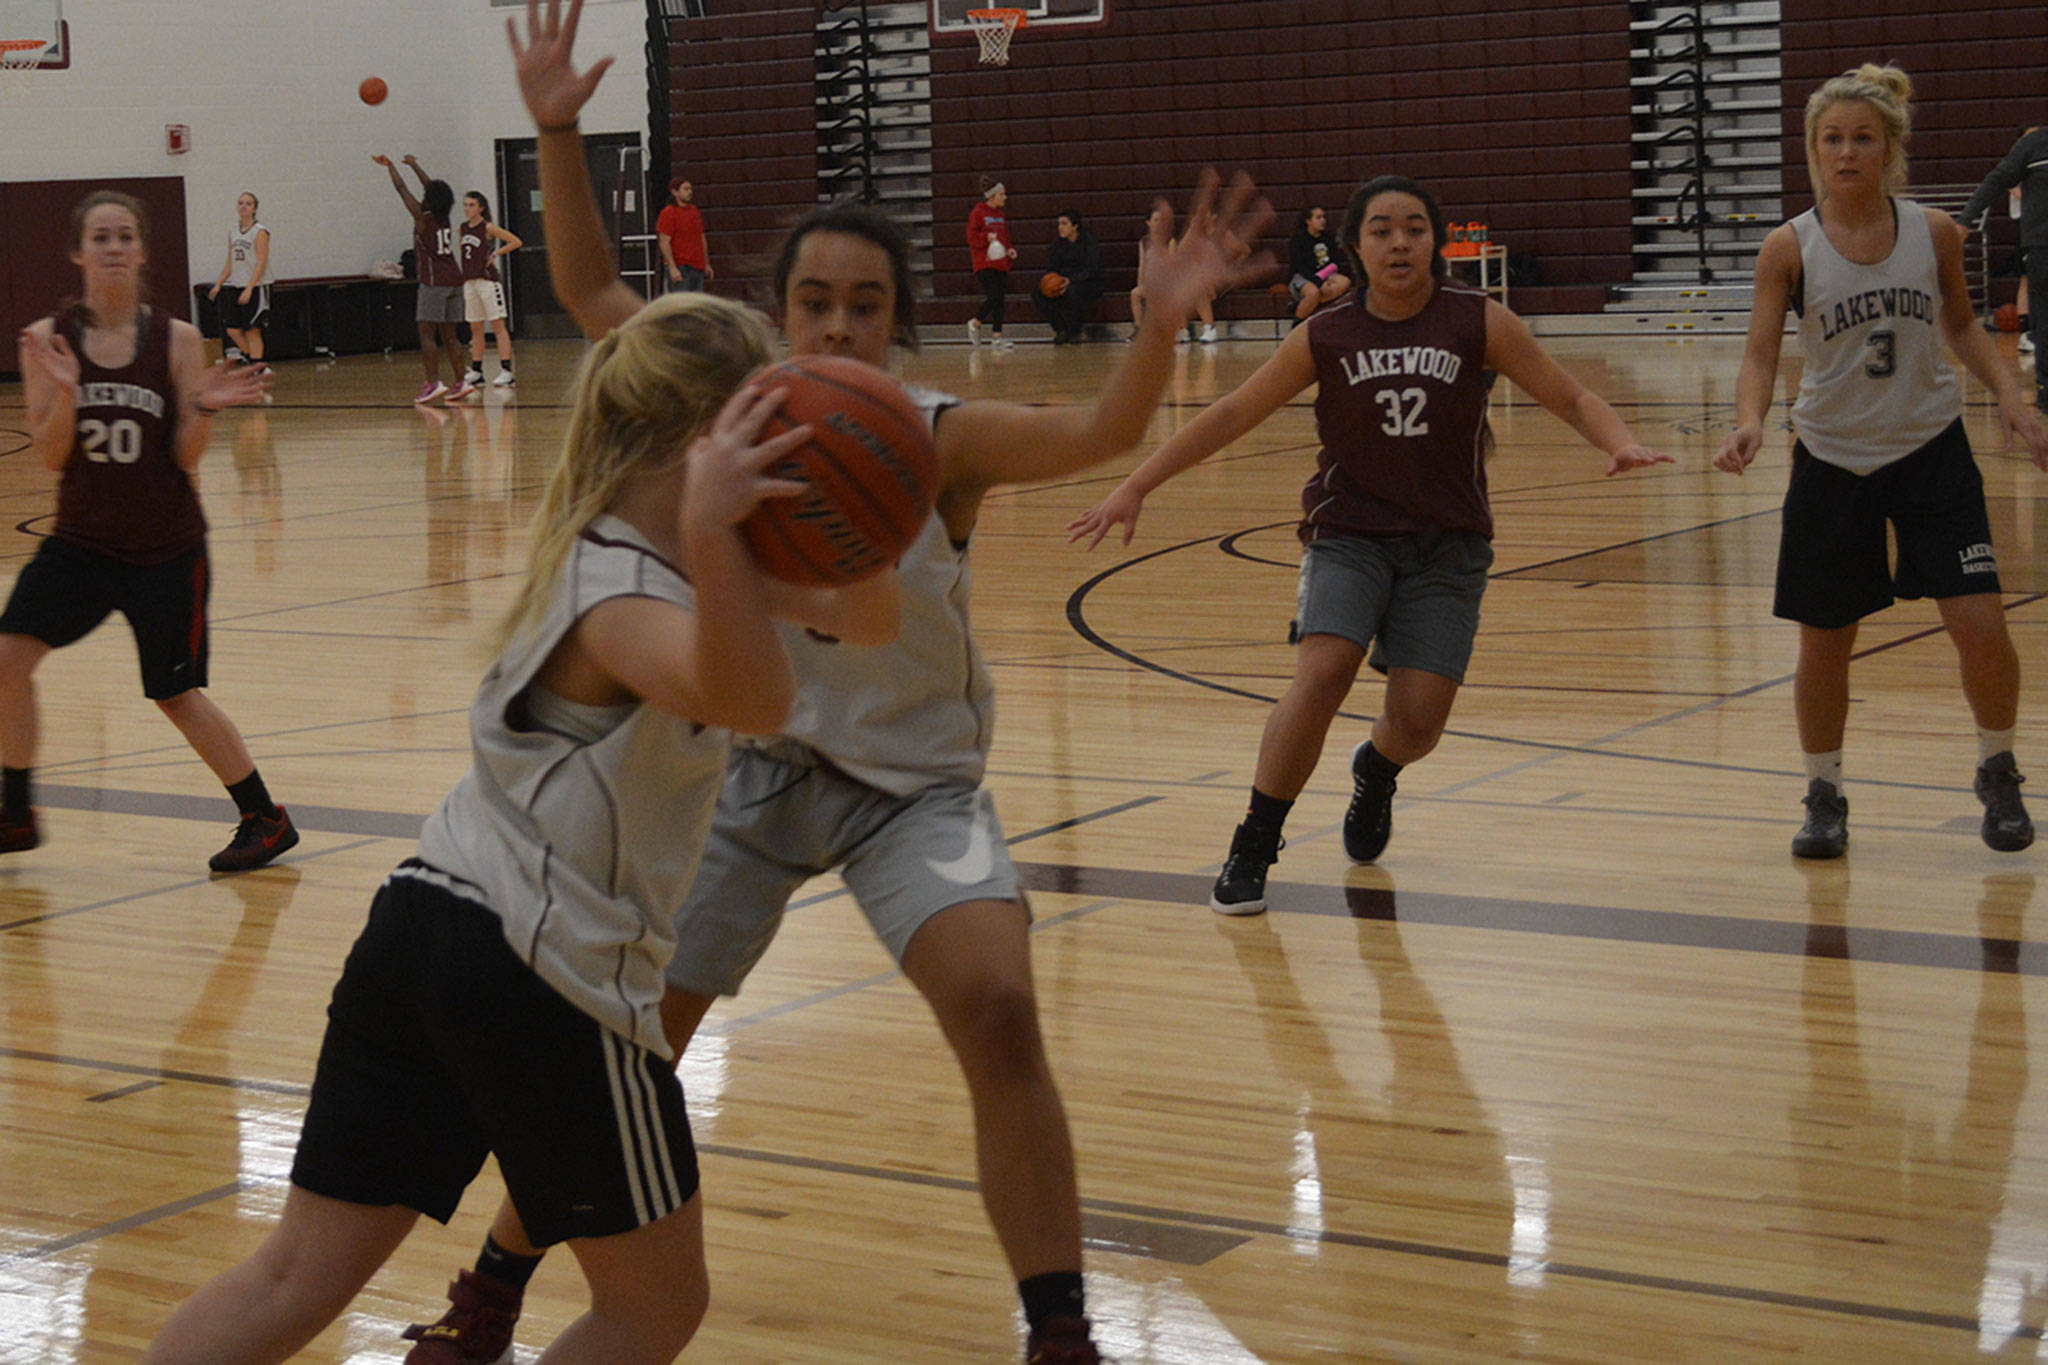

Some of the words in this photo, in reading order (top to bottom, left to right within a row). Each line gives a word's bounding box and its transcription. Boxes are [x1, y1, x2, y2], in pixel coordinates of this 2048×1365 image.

[436, 228, 451, 254] 15
[465, 245, 473, 260] 2
[1820, 287, 1933, 342] LAKEWOOD
[1340, 346, 1462, 386] LAKEWOOD
[1866, 329, 1897, 379] 3
[1374, 387, 1429, 437] 32
[79, 419, 142, 463] 20
